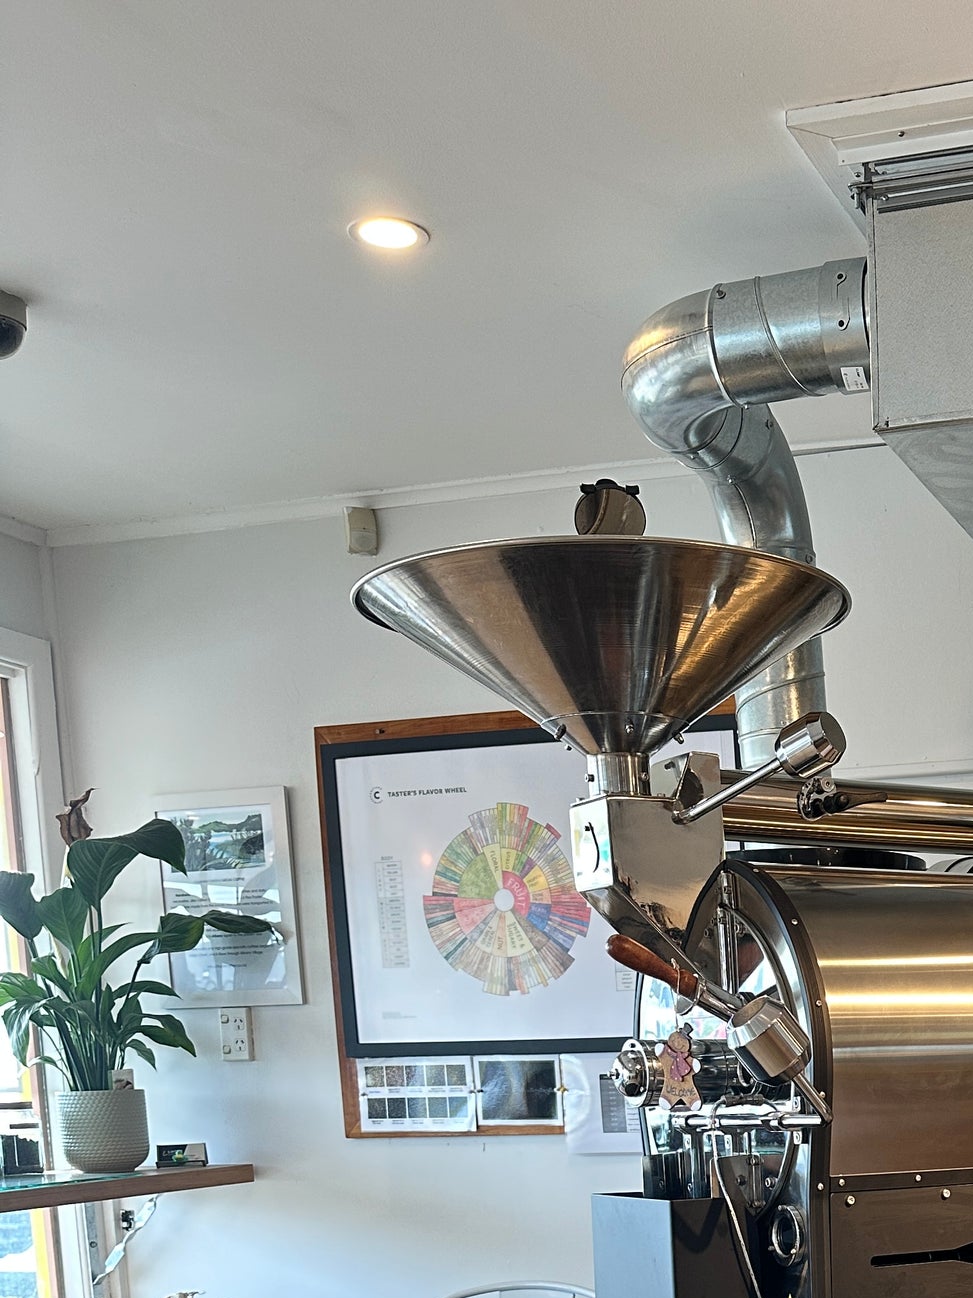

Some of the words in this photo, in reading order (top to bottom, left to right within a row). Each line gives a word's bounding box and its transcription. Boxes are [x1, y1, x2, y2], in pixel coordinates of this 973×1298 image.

[386, 789, 418, 798] TASTER'S
[418, 788, 443, 796] FLAVOR
[444, 786, 467, 794] WHEEL
[506, 878, 527, 909] FRUIT
[665, 1084, 697, 1097] WELCOME
